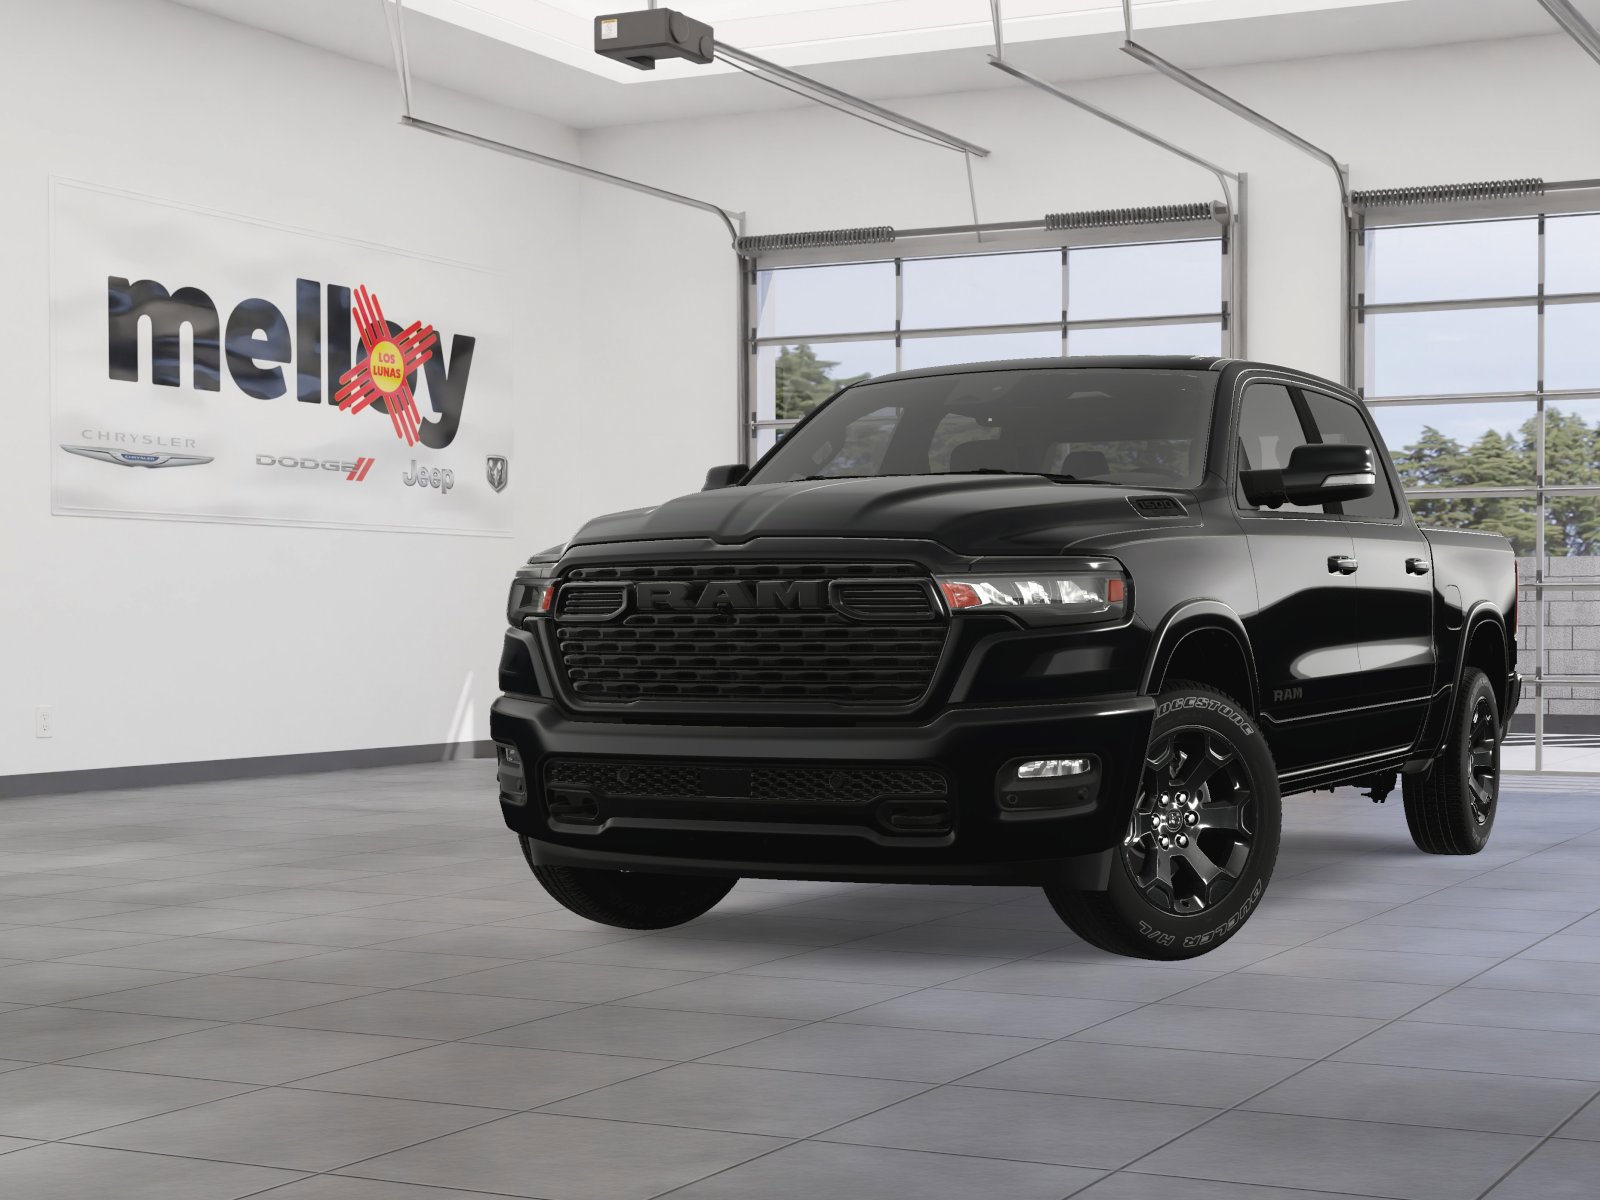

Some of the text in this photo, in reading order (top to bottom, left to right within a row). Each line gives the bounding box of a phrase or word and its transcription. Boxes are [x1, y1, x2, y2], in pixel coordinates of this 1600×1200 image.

[378, 351, 396, 364] LOS
[373, 365, 401, 378] LUNAS
[81, 429, 196, 448] CHRYSLER
[256, 454, 358, 473] DODGE
[402, 459, 454, 494] Jeep
[637, 580, 822, 610] RAM
[1273, 687, 1303, 702] RAM
[1154, 696, 1255, 736] DGESTONE
[1139, 878, 1262, 948] DUELER H/L
